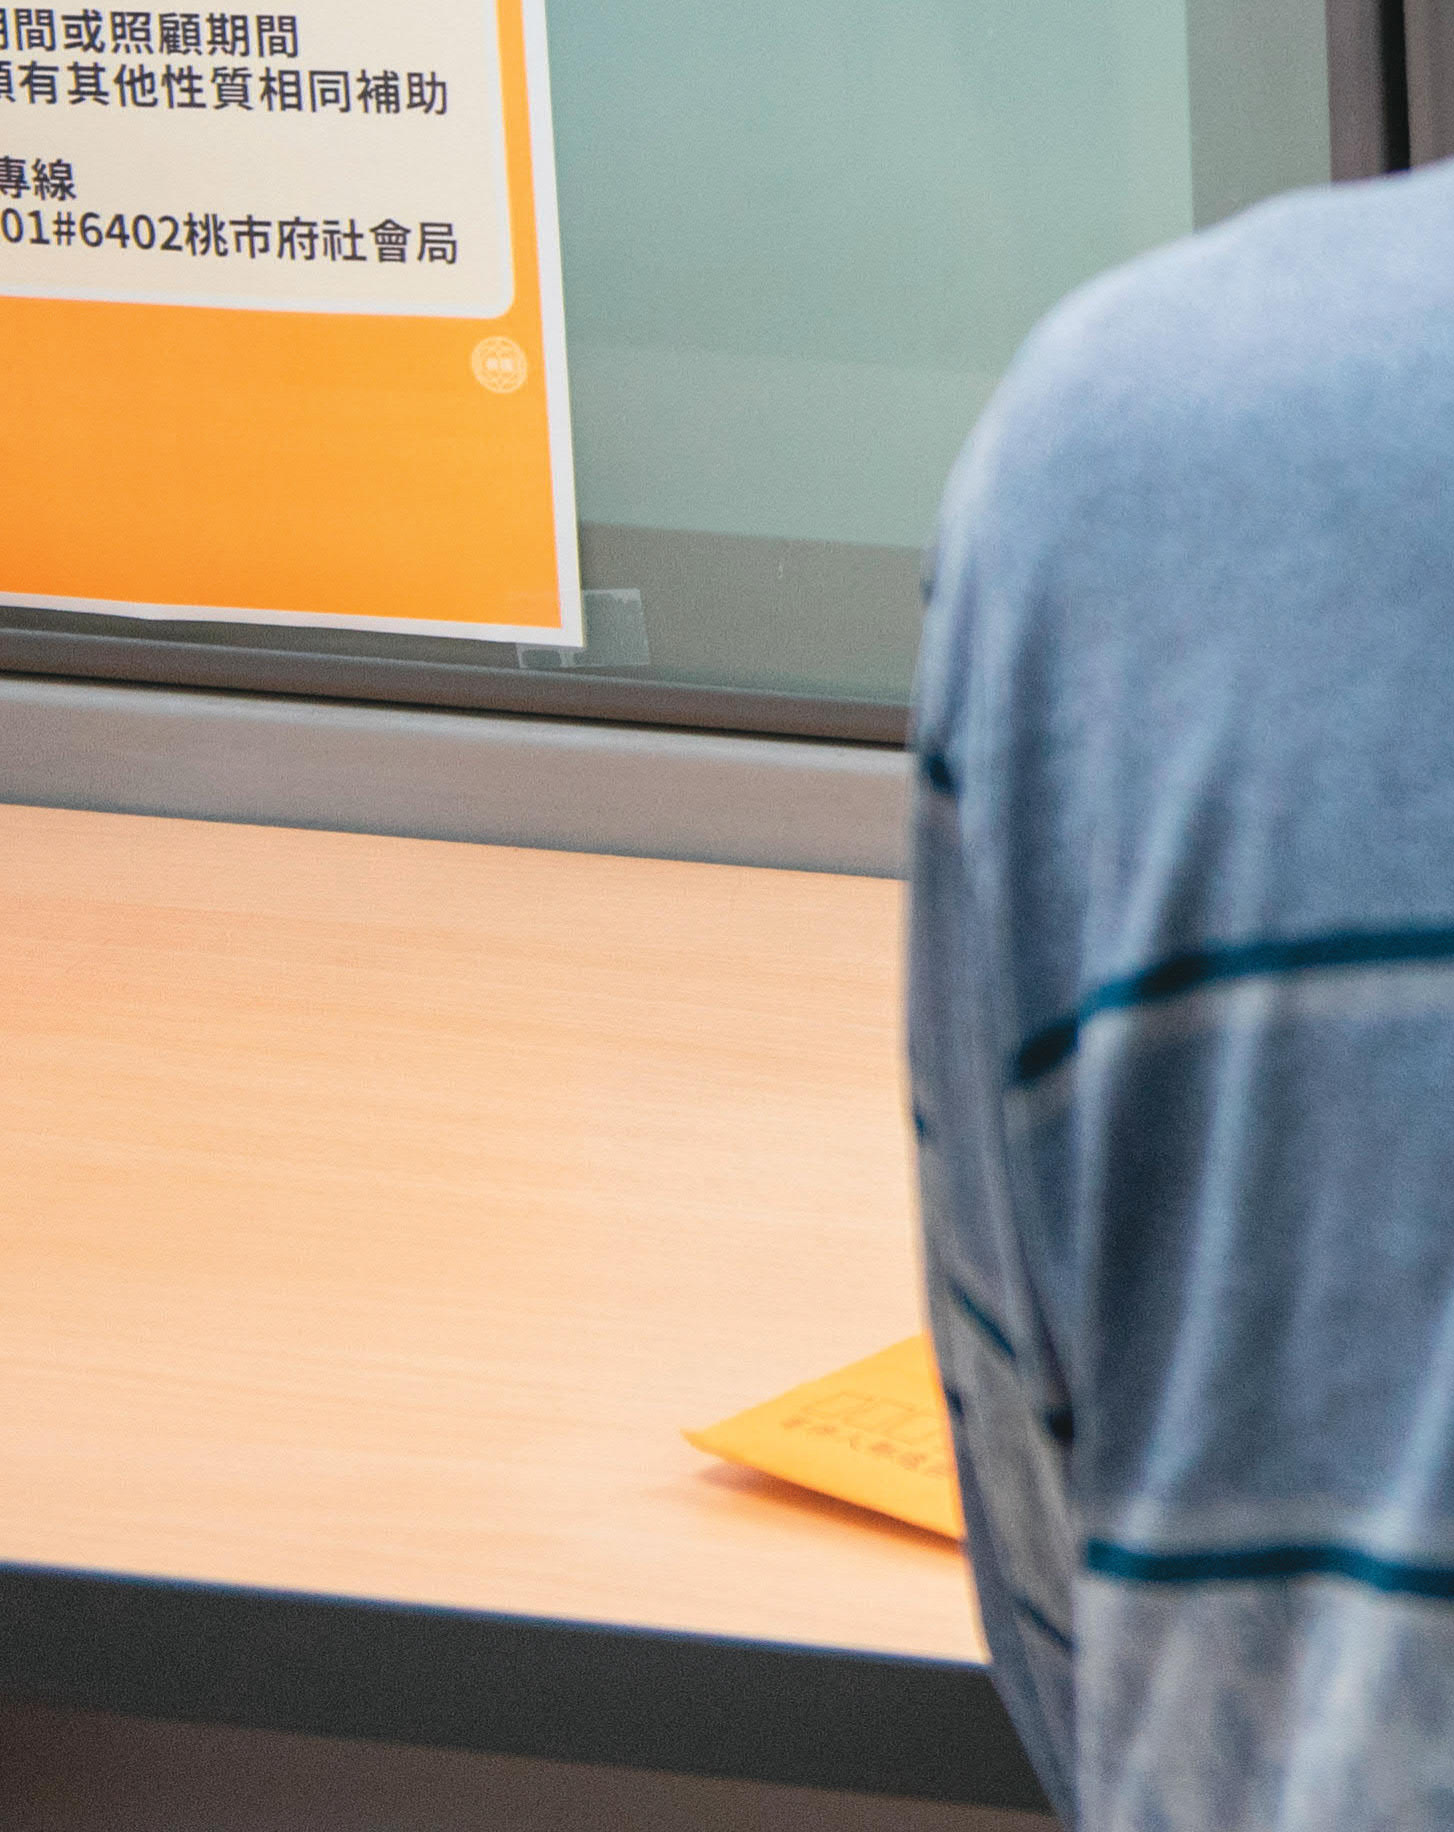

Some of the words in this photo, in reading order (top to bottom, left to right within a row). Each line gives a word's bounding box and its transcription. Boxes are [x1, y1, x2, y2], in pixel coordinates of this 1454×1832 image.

[0, 156, 77, 201] 專線
[1, 207, 458, 265] 01#6402桃市府社會局
